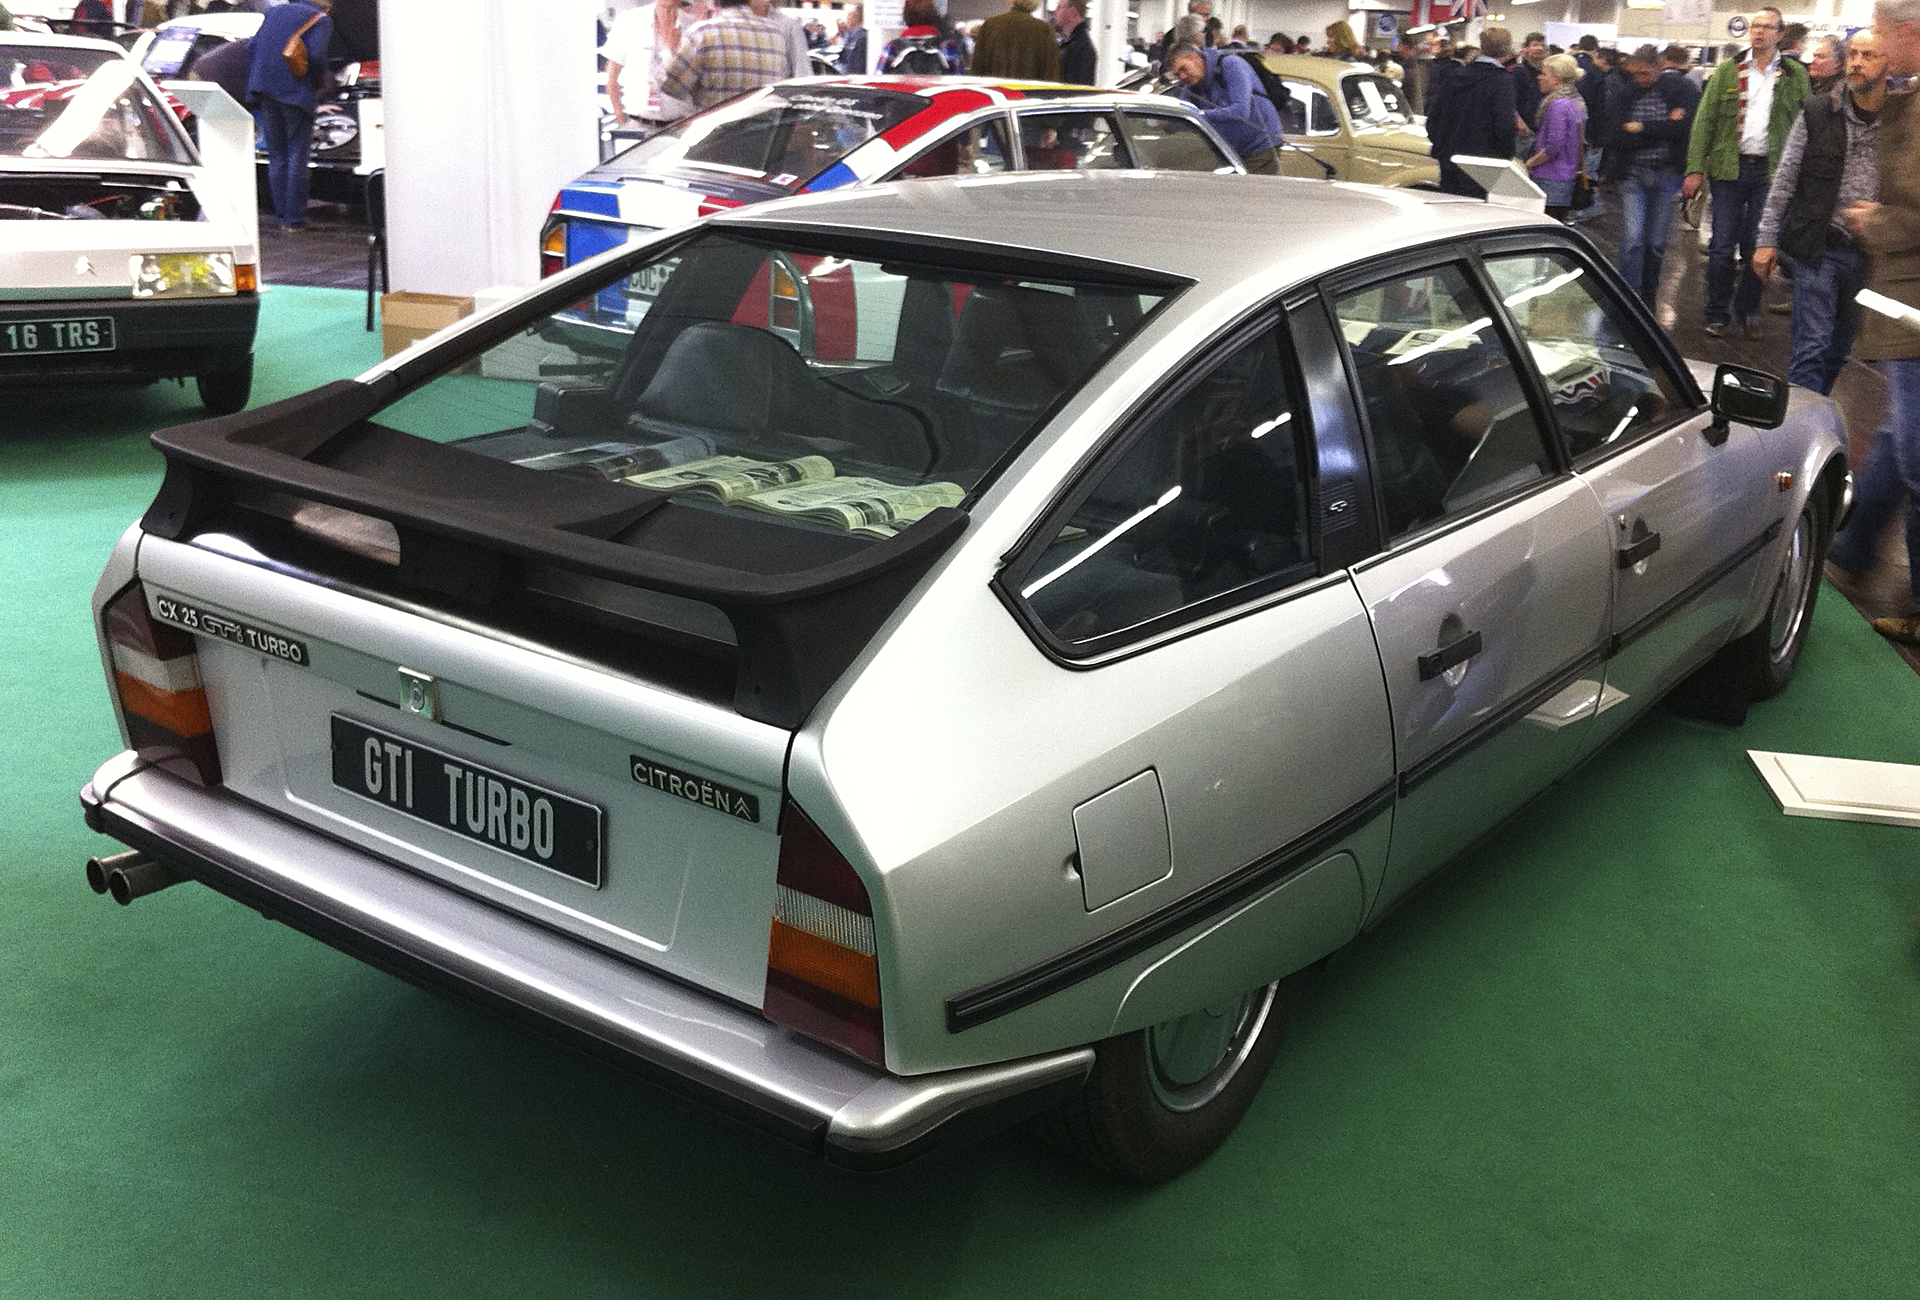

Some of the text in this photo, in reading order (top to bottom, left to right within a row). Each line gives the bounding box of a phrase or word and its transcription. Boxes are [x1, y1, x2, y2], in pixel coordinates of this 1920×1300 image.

[5, 321, 100, 350] 16 TRS
[158, 599, 179, 621] CX
[181, 607, 199, 627] 25
[247, 629, 302, 662] TURBO
[364, 737, 554, 860] GTI TURBO
[633, 763, 731, 813] CITROËN
